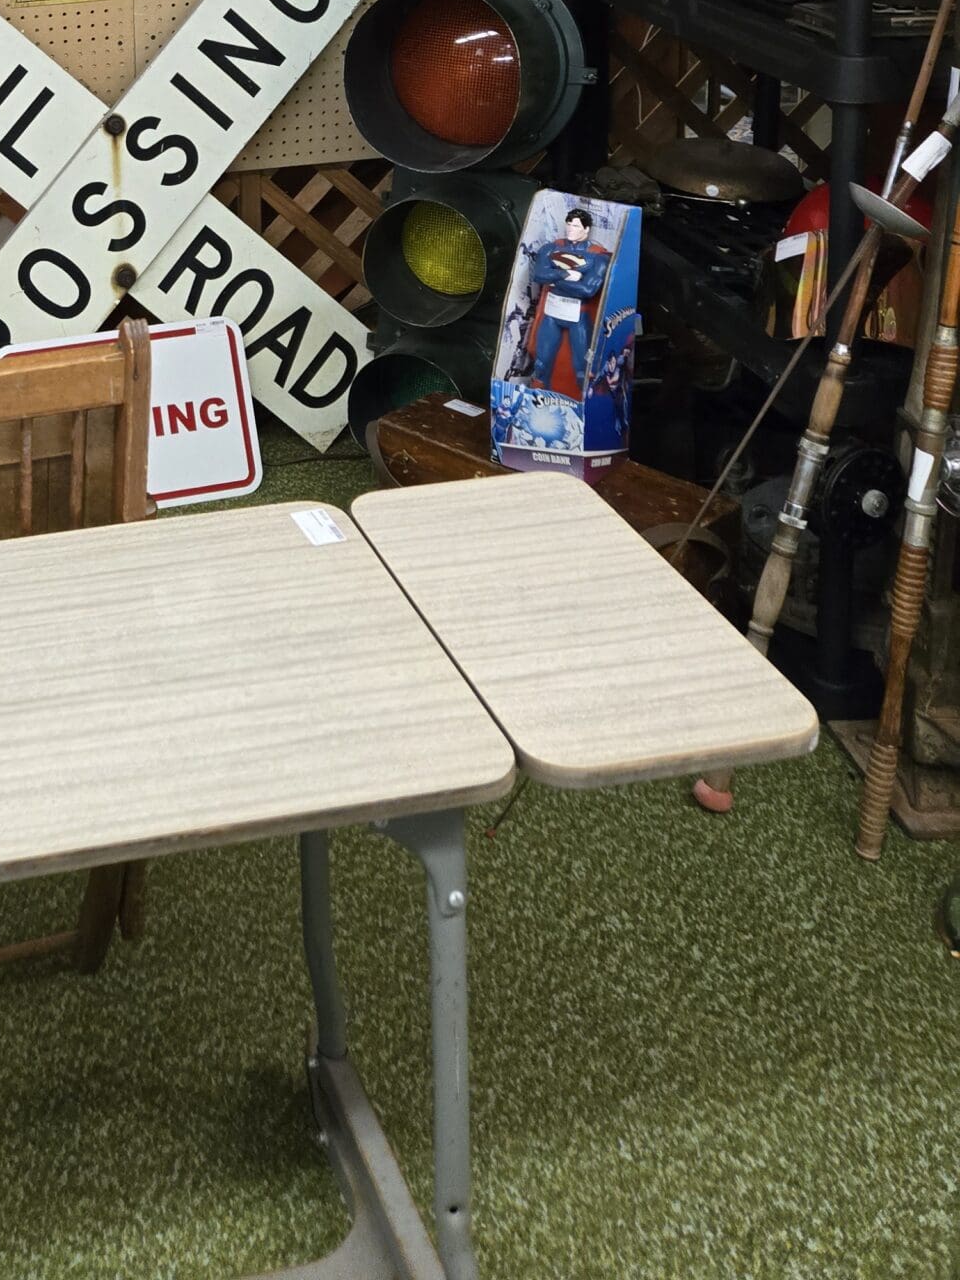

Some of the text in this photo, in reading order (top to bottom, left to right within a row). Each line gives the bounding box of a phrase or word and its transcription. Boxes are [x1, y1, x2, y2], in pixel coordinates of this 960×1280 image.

[158, 225, 359, 409] ROAD
[532, 452, 571, 466] COIN BANK
